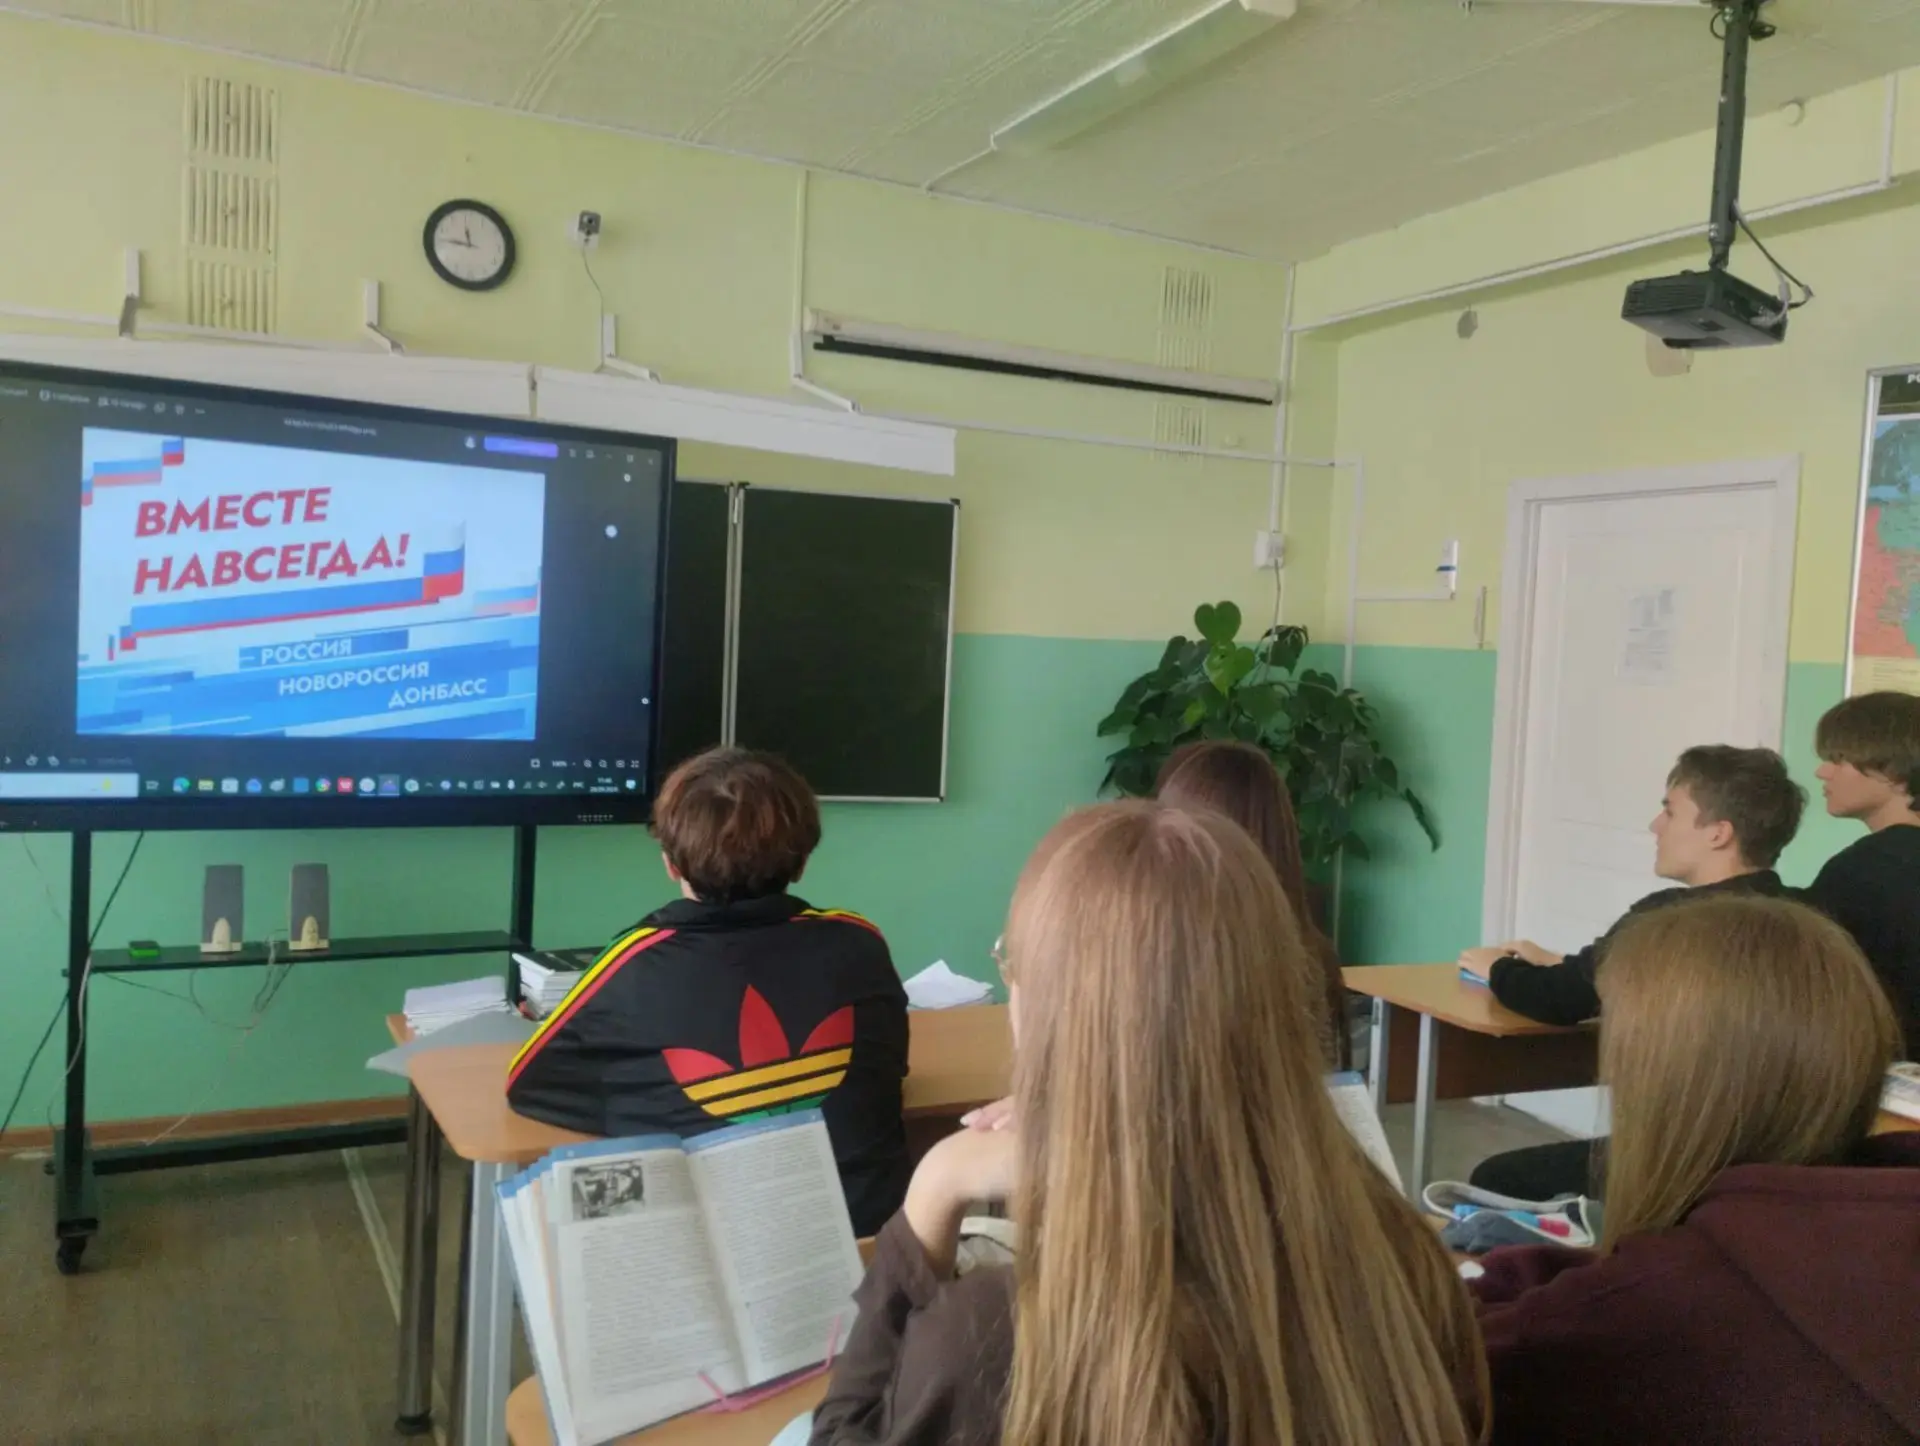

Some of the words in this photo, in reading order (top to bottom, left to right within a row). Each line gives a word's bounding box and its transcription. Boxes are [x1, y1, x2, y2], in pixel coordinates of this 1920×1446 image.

[134, 487, 331, 537] ВМЕСТЕ
[133, 533, 410, 594] НАВСЕГДА!
[261, 638, 352, 665] РОССИЯ
[279, 661, 429, 695] НОВОРОССИЯ
[388, 678, 487, 708] ДОНБАСС
